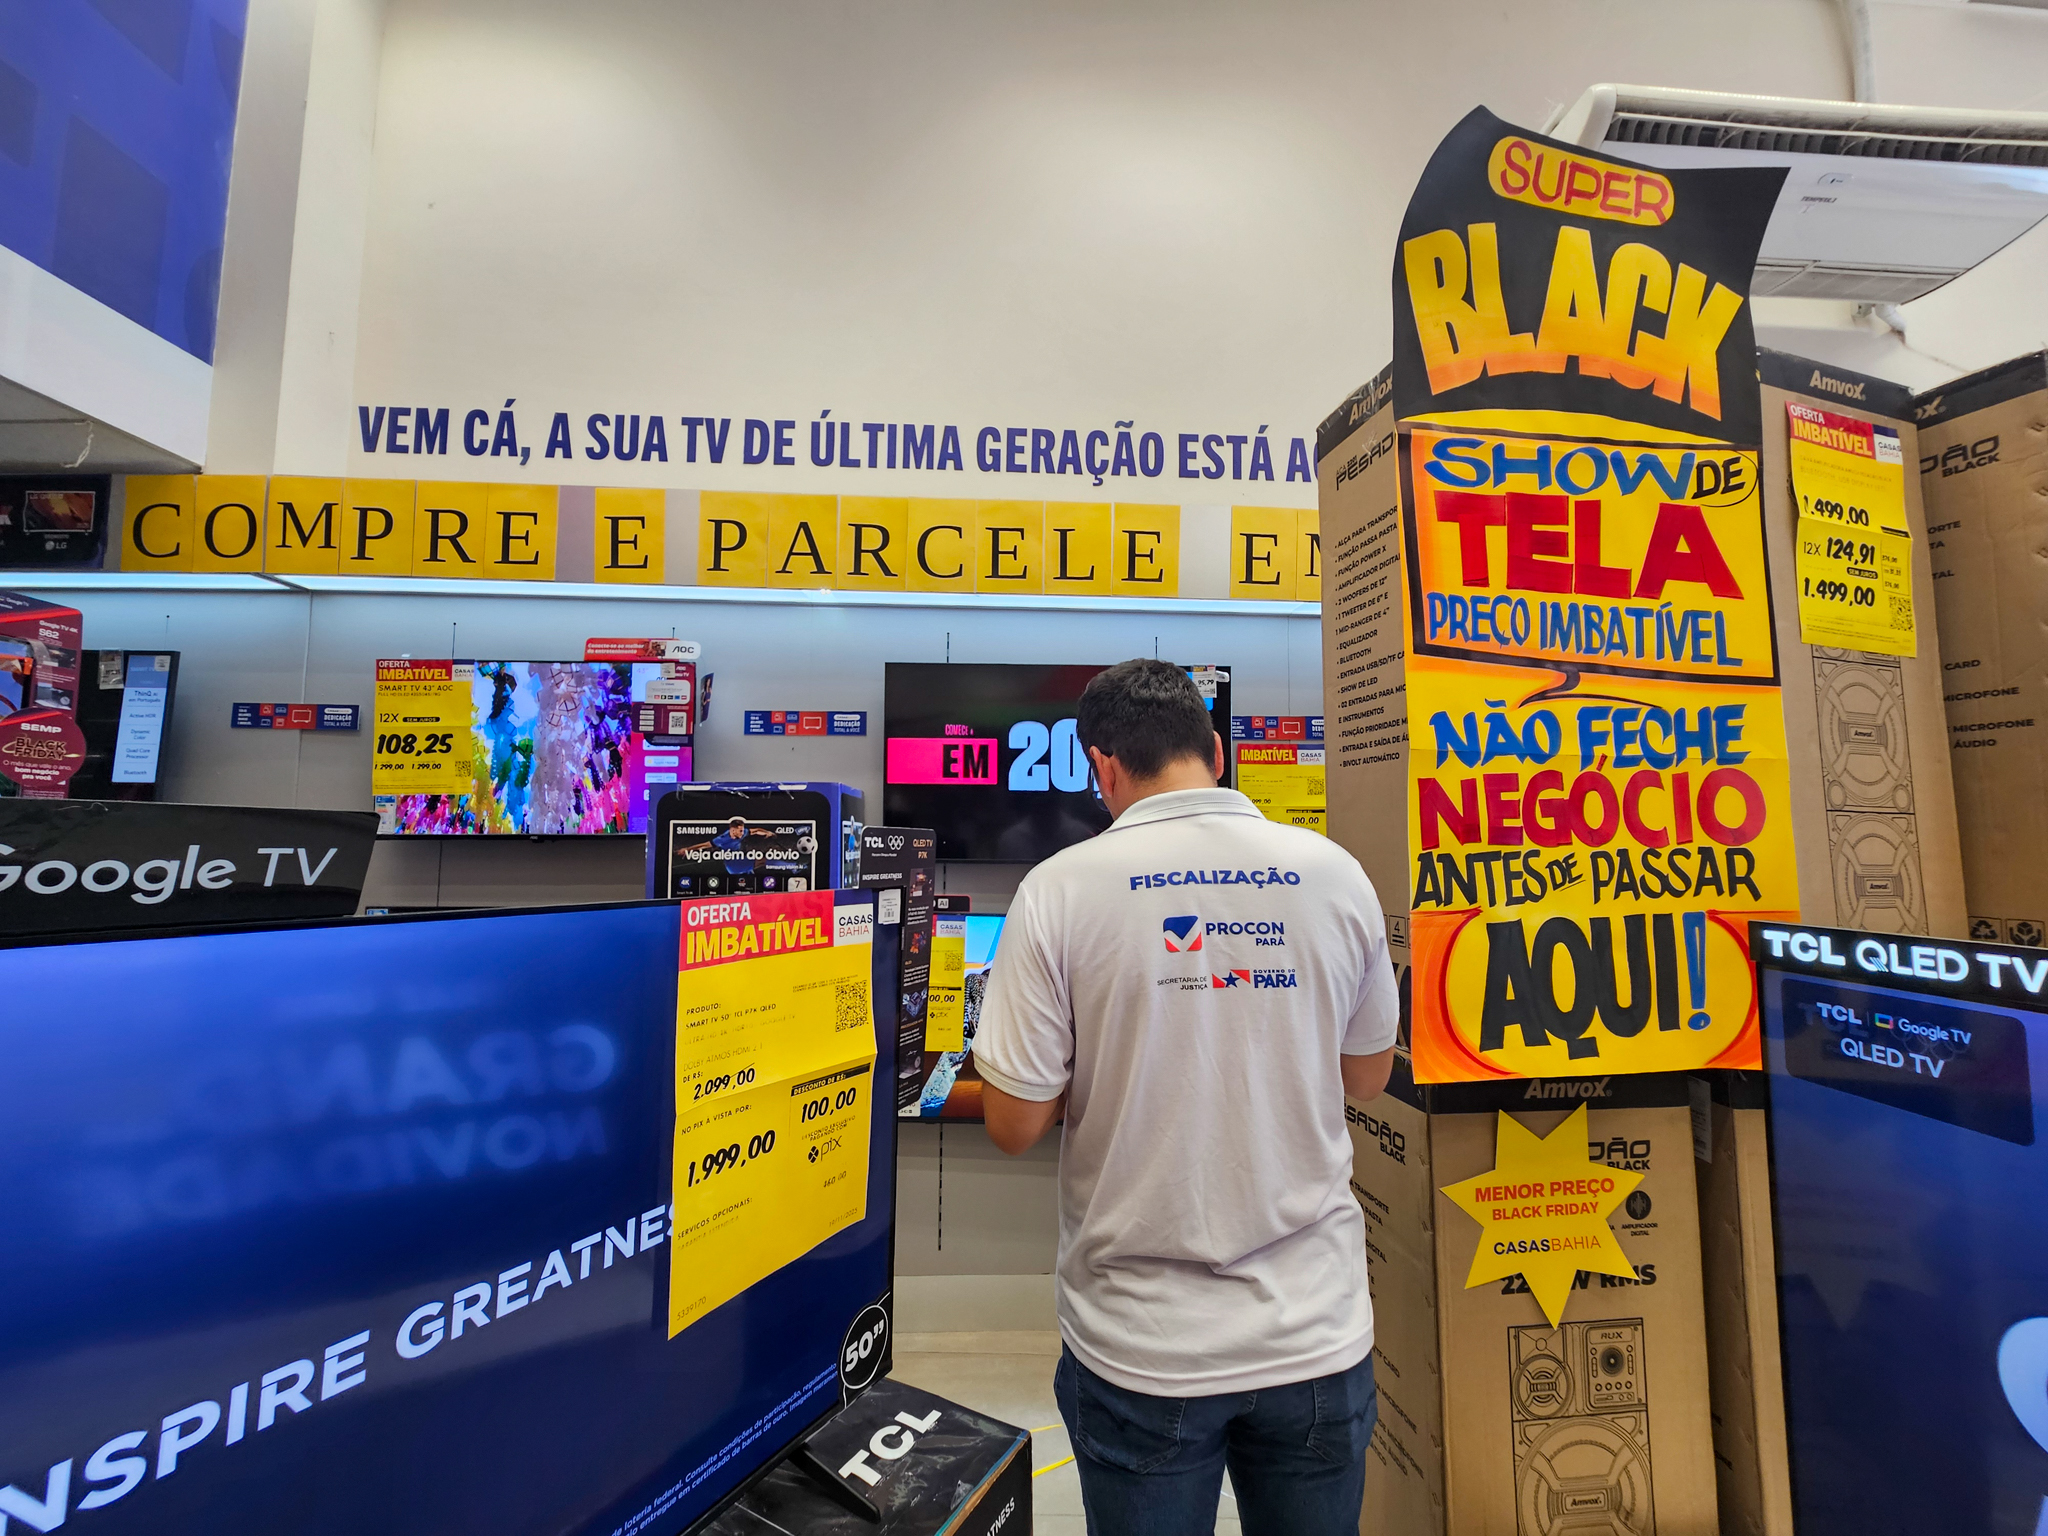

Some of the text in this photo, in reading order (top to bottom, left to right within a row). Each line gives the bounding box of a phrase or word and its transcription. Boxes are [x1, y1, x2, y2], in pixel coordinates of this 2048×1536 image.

[1500, 140, 1670, 225] SUPER
[1403, 222, 1744, 421] BLACK
[1809, 369, 1865, 400] Amvox
[1790, 404, 1825, 425] OFERTA
[358, 398, 1273, 486] VEM CÁ, A SUA TV DE ÚLTIMA GERAÇÃO ESTÁ
[1793, 417, 1902, 456] IMBATÍVEL CASAS
[1424, 437, 1697, 500] SHOW
[1691, 456, 1747, 500] DE
[1942, 452, 2000, 478] BLACK
[132, 501, 1164, 583] COMPRE E PARCELE
[1338, 522, 1398, 563] FUNÇÃO PASSA PASTA
[1351, 526, 1367, 542] PARA
[1434, 490, 1745, 600] TELA
[1338, 548, 1382, 577] FUNÇÃO POWER
[1803, 536, 1875, 566] 12X 124,91
[1338, 564, 1379, 592] AMPLIFICADOR
[1342, 585, 1370, 604] WOOFERS
[1804, 577, 1875, 607] 1.499,00
[1341, 601, 1367, 619] TWEETER
[1339, 629, 1378, 651] EQUALIZADOR
[1426, 591, 1531, 648] PREÇO
[1539, 600, 1744, 667] IMBATÍVEL
[672, 646, 695, 654] AOC
[1339, 647, 1372, 665] BLUETOOTH
[378, 660, 410, 668] OFERTA
[378, 666, 449, 680] IMBATÍVEL
[1340, 664, 1366, 679] ENTRADA
[1944, 659, 1981, 671] CARD
[1340, 676, 1378, 694] SHOW LED
[1348, 688, 1395, 707] ENTRADAS PARA
[379, 713, 400, 723] 12X
[1342, 706, 1385, 723] INSTRUMENTOS
[1953, 719, 2035, 734] MICROFONE
[21, 723, 62, 733] SEMP
[945, 724, 969, 736] COMECE
[1341, 718, 1400, 739] FUNÇÃO PRIORIDADE
[1429, 698, 1752, 771] NÃO FECHE
[14, 747, 65, 760] FRIDAY
[15, 736, 66, 752] BLACK
[377, 733, 454, 757] 108,25
[1241, 747, 1295, 761] IMBATÍVEL
[1342, 735, 1392, 753] ENTRADA SAÍDA
[1953, 738, 1997, 749] ÁUDIO
[942, 744, 989, 779] EM
[1342, 752, 1400, 768] BIVOLT AUTOMÁTICO
[1418, 753, 1767, 851] NEGÓCIO
[676, 826, 795, 835] SAMSUNG QLED
[1292, 817, 1319, 826] 100,00
[865, 837, 926, 848] TCL QLED
[256, 847, 339, 888] TV
[685, 849, 800, 863] Veja além do óbvio
[1129, 867, 1301, 891] FISCALIZAÇÃO
[1411, 846, 1762, 911] ANTES DE PASSAR
[687, 902, 752, 927] OFERTA
[686, 914, 829, 965] IMBATÍVEL
[838, 914, 873, 926] CASAS
[838, 926, 870, 938] BAHIA
[1205, 921, 1285, 936] PROCON
[1255, 935, 1285, 947] PARÁ
[1762, 929, 2048, 994] TCL QLED TV
[1156, 977, 1198, 986] SECRETARIA
[1180, 983, 1208, 991] JUSTIÇA
[1479, 911, 1712, 1061] AQUI!
[686, 1002, 721, 1015] PRODUTO:
[685, 1018, 709, 1030] SMART
[1816, 1002, 1972, 1045] TCL Google TV
[1840, 1037, 1945, 1079] QLED TV
[693, 1067, 756, 1101] 2.099,00
[793, 1080, 826, 1096] DESCONTO
[1524, 1077, 1607, 1100] Amvox
[801, 1087, 857, 1124] 100,00
[681, 1104, 752, 1136] NO PIX VISTA POR:
[687, 1129, 776, 1188] 1.999,00
[820, 1135, 843, 1162] pix
[1380, 1141, 1406, 1166] BLACK
[1354, 1181, 1390, 1215] TRANSPORTE
[1475, 1178, 1615, 1204] MENOR PREÇO
[678, 1217, 710, 1241] SERVICOS
[712, 1197, 753, 1221] OPCIONAIS:
[1364, 1206, 1384, 1227] PASTA
[1492, 1201, 1600, 1221] BLACK FRIDAY
[1365, 1238, 1387, 1264] DIGITAL
[676, 1296, 707, 1322] 5339170
[624, 1504, 652, 1531] loteria
[653, 1479, 684, 1508] federal.
[685, 1453, 718, 1483] Consulte
[719, 1426, 753, 1457] condições
[802, 1363, 837, 1393] regulamento
[838, 1409, 942, 1487] TCL
[640, 1390, 813, 1530] entregue certificado barras Imagem
[1570, 1494, 1602, 1508] Amvox
